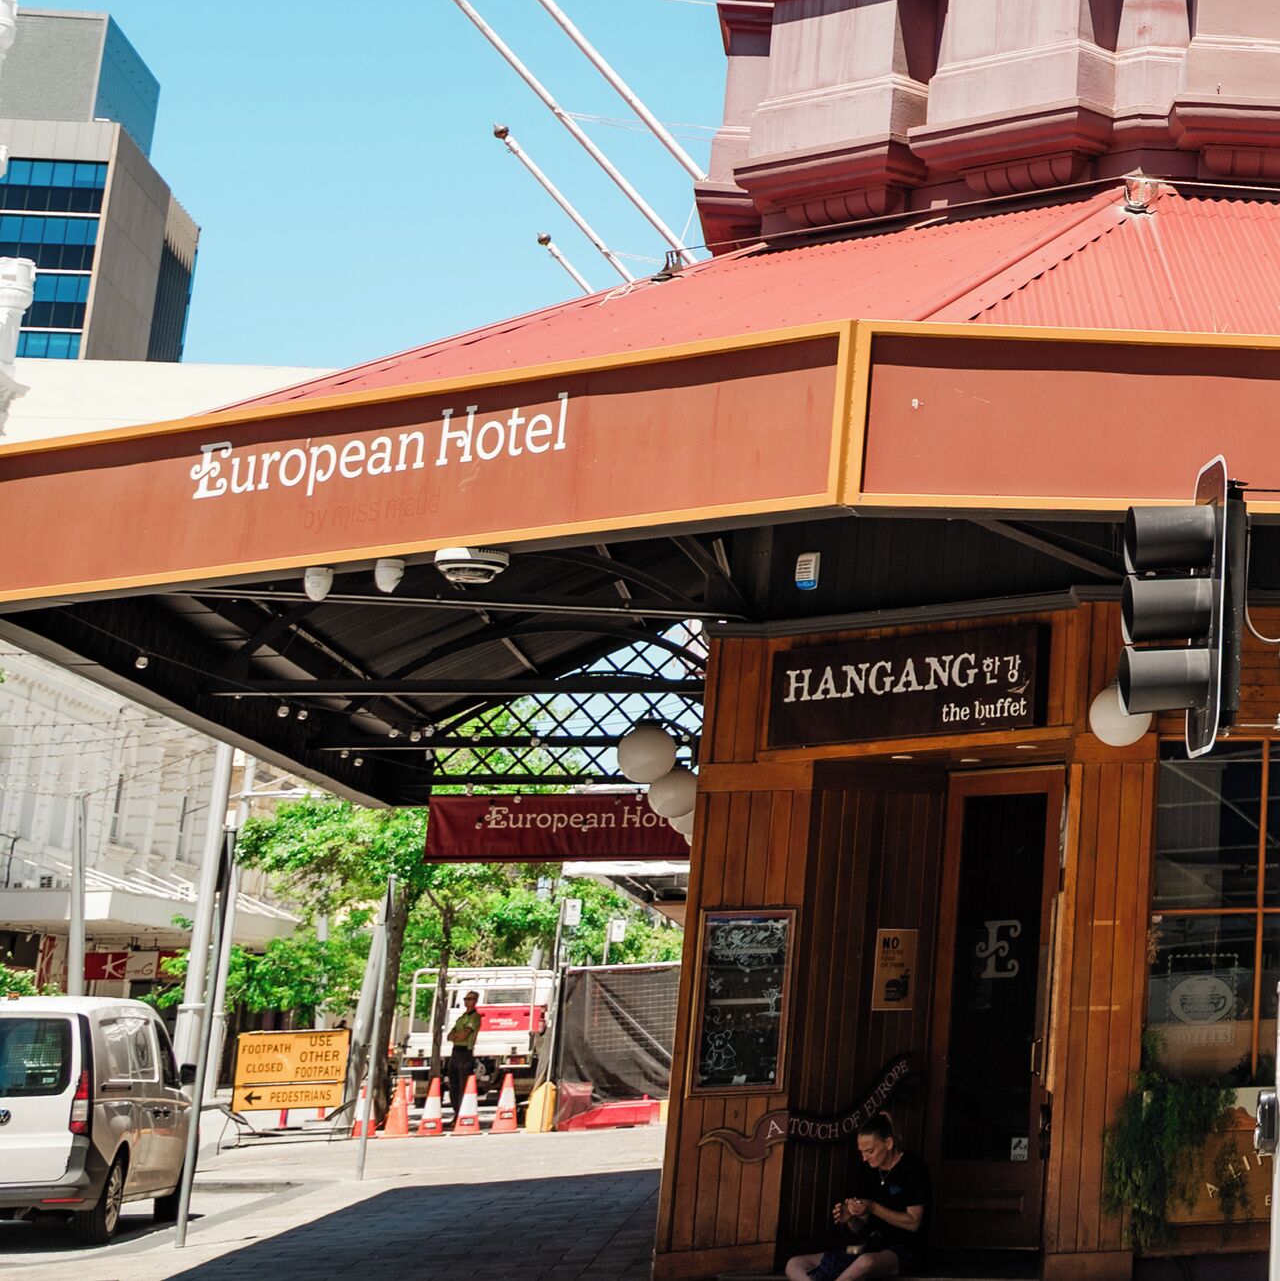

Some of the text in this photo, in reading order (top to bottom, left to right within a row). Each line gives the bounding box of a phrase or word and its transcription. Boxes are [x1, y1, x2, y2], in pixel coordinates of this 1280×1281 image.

[190, 392, 569, 497] European Hotel
[784, 653, 1021, 703] HANGANG 한강
[942, 697, 1027, 723] the buffet
[485, 806, 672, 832] European Hot
[883, 937, 899, 949] NO
[309, 1034, 333, 1047] USE
[242, 1043, 291, 1054] FOOTPATH
[300, 1050, 340, 1062] OTHER
[246, 1062, 283, 1073] CLOSED
[295, 1065, 341, 1078] FOOTPATH
[270, 1089, 332, 1103] PEDESTRIANS
[766, 1060, 909, 1139] A TOUCH OF EUROPE
